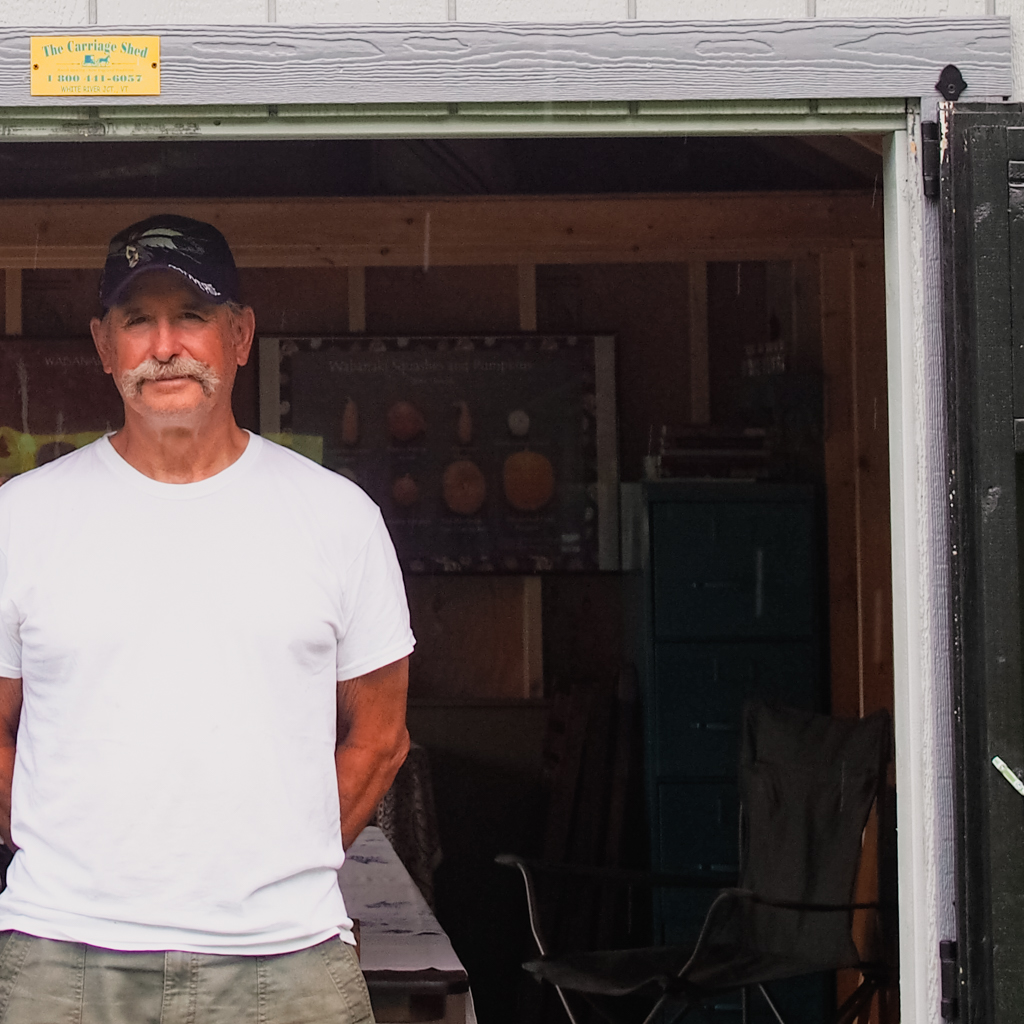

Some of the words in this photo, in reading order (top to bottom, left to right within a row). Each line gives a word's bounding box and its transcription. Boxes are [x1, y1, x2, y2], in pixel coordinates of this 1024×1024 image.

[42, 44, 64, 57] The
[67, 39, 117, 55] Carriage
[120, 42, 148, 58] Shed
[57, 74, 80, 82] 800
[61, 85, 81, 93] WHITE
[83, 85, 100, 93] RIVER
[120, 85, 128, 93] VT
